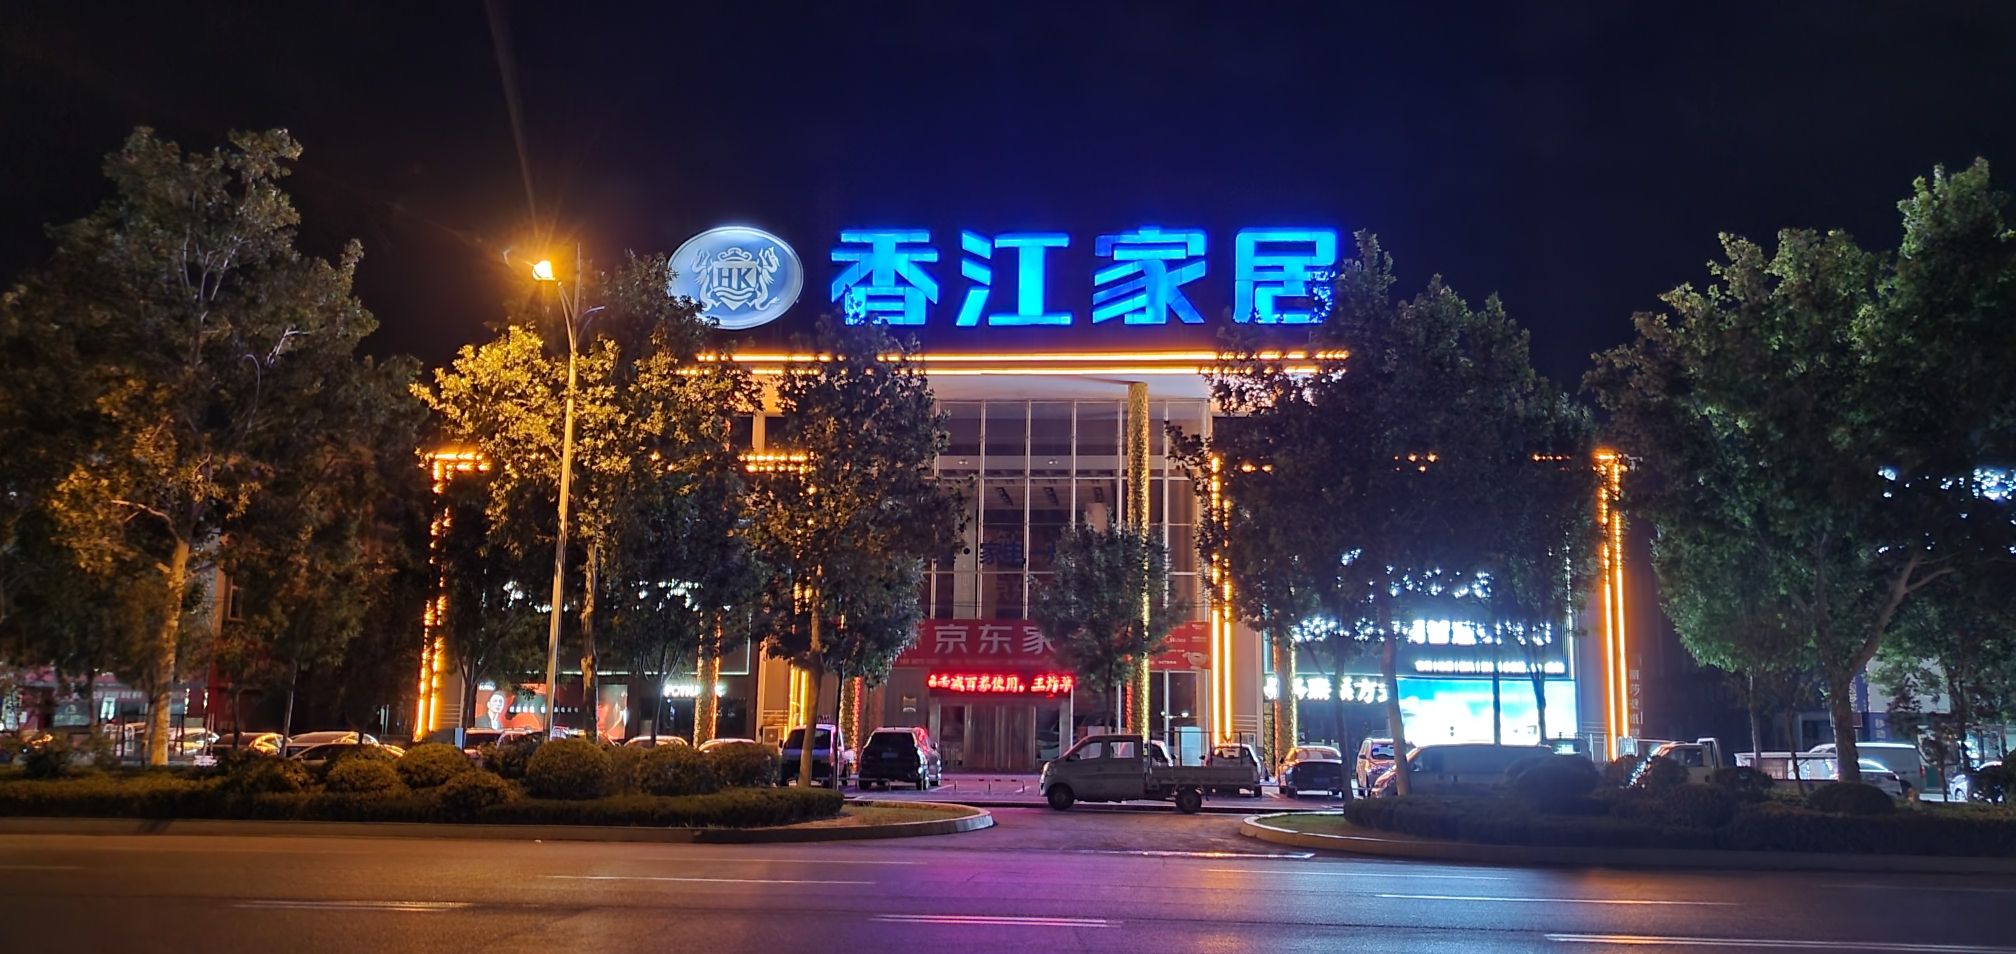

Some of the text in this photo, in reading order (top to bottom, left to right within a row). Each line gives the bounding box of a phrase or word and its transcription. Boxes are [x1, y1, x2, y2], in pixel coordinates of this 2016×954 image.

[717, 267, 753, 291] HK
[830, 226, 1337, 326] 香江家居
